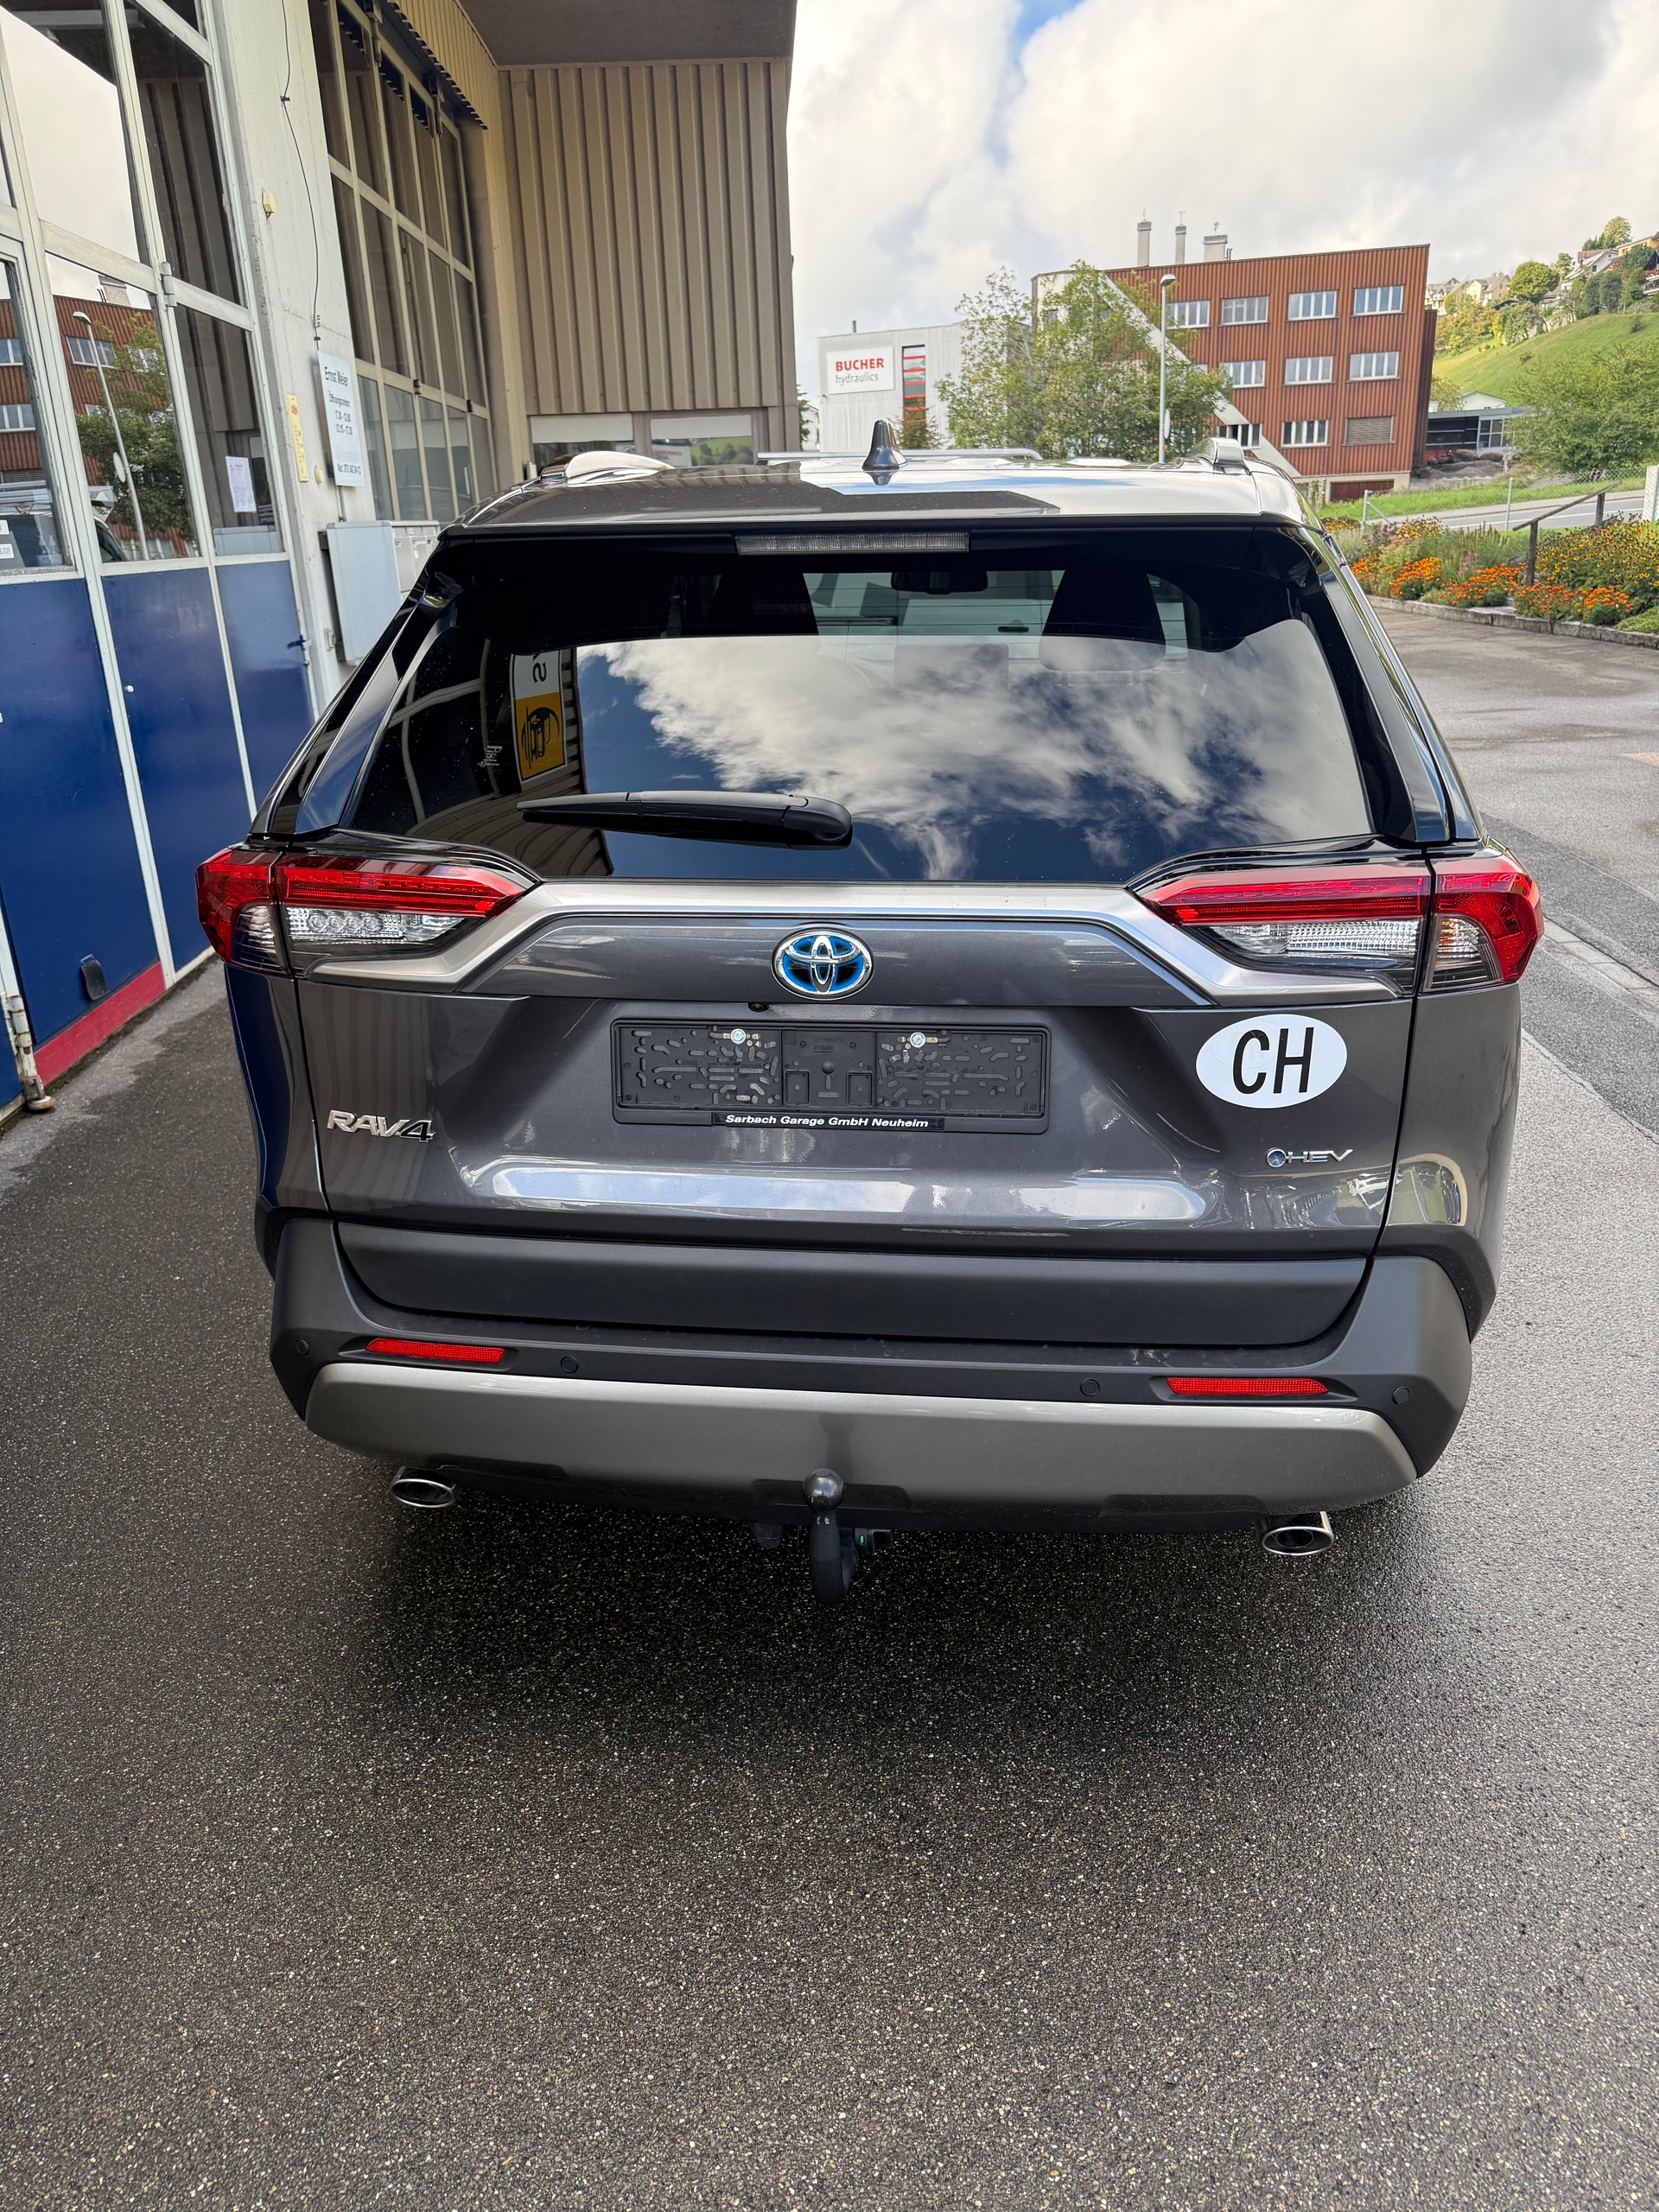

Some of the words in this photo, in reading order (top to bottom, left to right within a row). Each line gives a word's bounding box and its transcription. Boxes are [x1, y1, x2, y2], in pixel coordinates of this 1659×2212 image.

[836, 358, 885, 372] BUCHER
[324, 365, 337, 384] Ernst
[836, 372, 879, 386] hydraulics
[1232, 1027, 1314, 1095] CH
[327, 1109, 435, 1142] RAV4
[725, 1115, 777, 1125] Sarbach
[780, 1116, 824, 1126] Garage
[828, 1116, 868, 1127] GmbH
[871, 1118, 929, 1128] Neuheim
[1287, 1149, 1353, 1164] HEV
